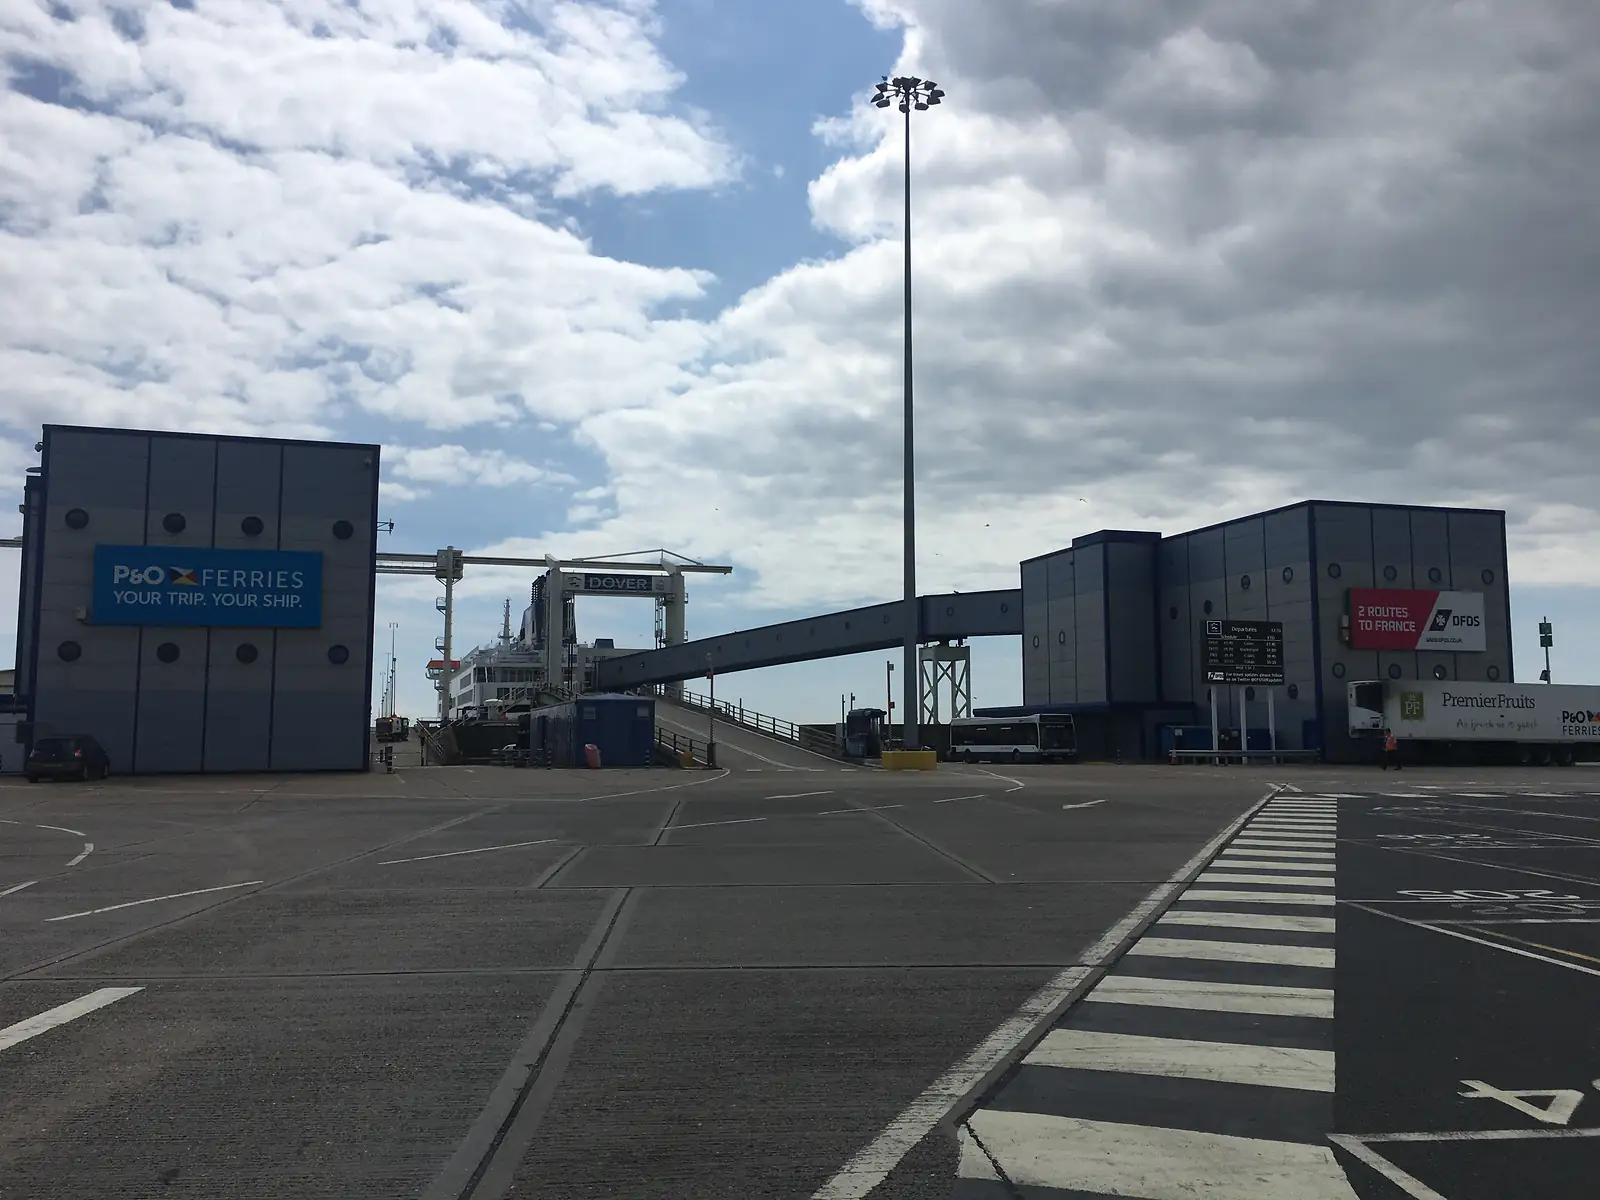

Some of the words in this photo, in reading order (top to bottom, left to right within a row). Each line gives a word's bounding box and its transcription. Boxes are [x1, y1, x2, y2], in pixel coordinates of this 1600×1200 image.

[113, 565, 165, 585] P&O
[202, 569, 304, 588] FERRIES
[589, 577, 648, 590] DOVER
[113, 590, 162, 605] YOUR
[167, 591, 206, 606] TRIP.
[211, 593, 258, 607] YOUR
[263, 594, 302, 608] SHIP.
[1358, 605, 1365, 617] 2
[1368, 606, 1409, 618] ROUTES
[1358, 620, 1373, 631] TO
[1375, 620, 1416, 632] FRANCE
[1452, 615, 1480, 627] DFDS
[1442, 692, 1536, 709] PremierFruits
[1404, 701, 1421, 715] PF
[1562, 711, 1586, 724] P&O
[1397, 889, 1581, 900] 205
